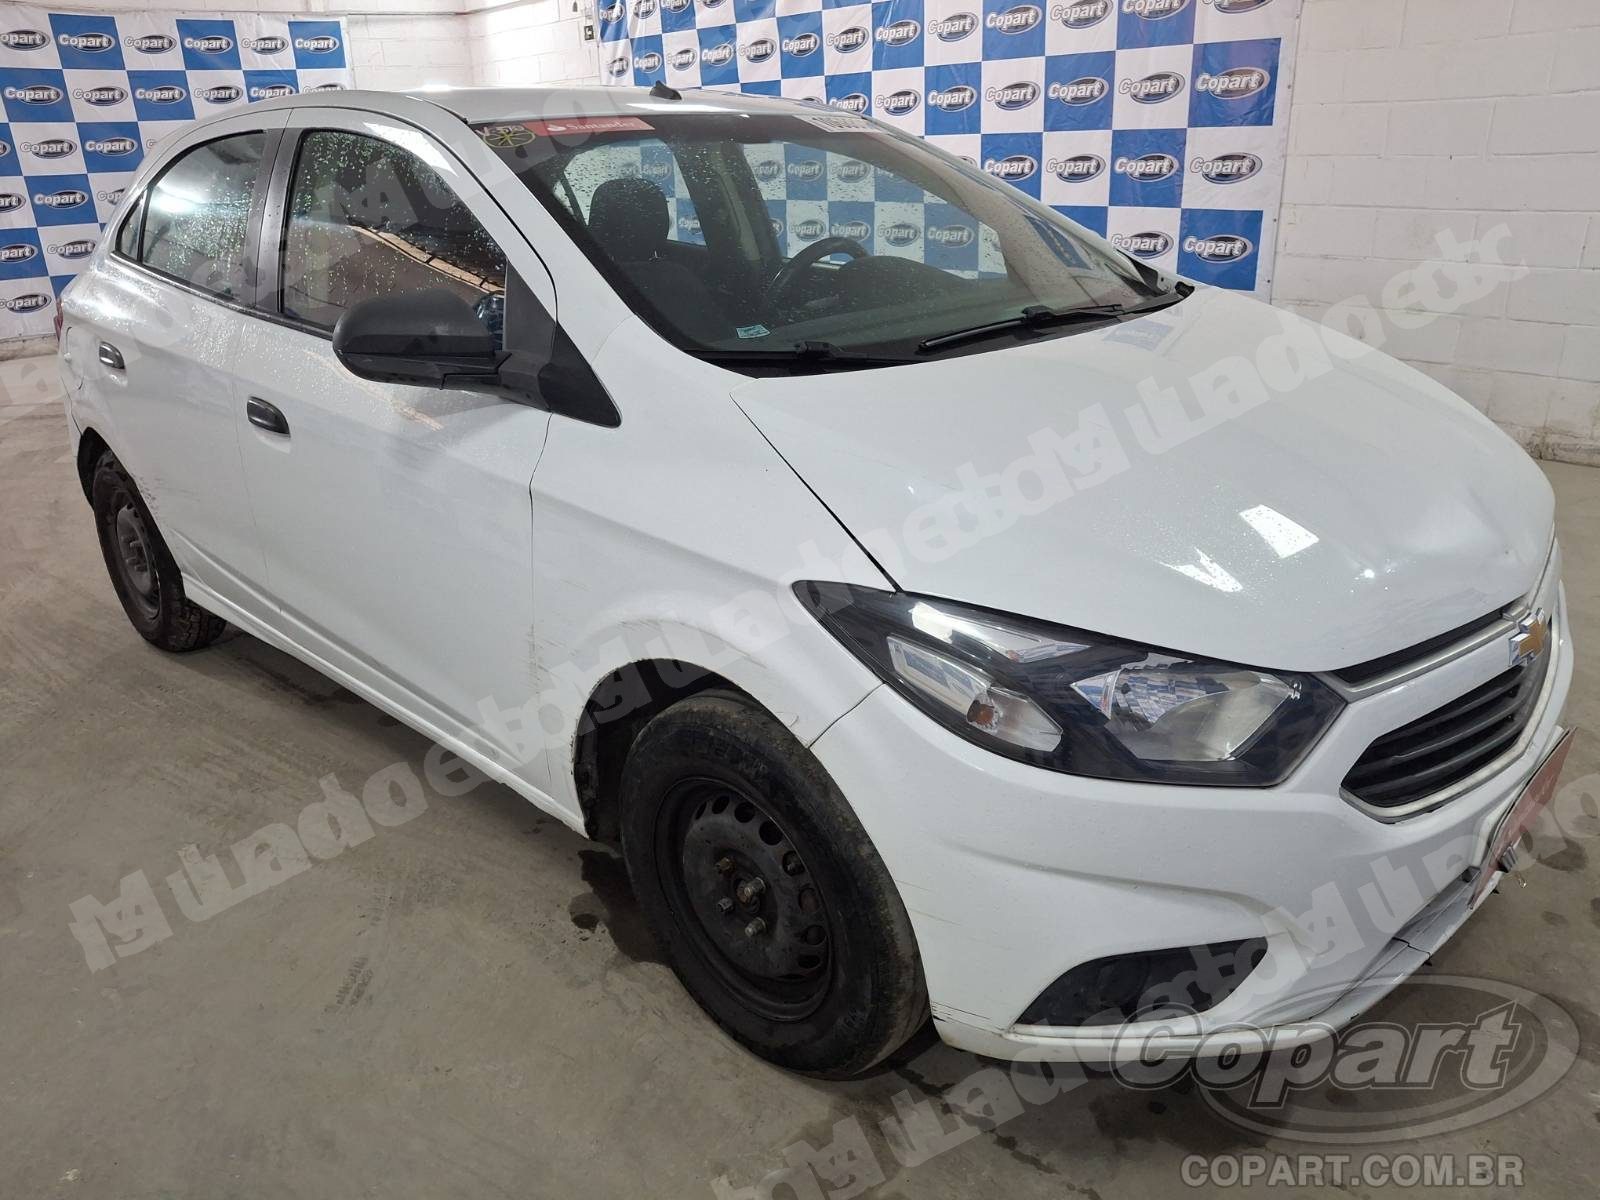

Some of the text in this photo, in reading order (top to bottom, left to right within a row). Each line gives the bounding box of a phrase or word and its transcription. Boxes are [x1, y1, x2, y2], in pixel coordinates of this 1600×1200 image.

[1051, 2, 1106, 22] Copart
[928, 17, 972, 35] Copart
[986, 11, 1035, 30] Copart
[0, 32, 42, 45] opart
[58, 34, 109, 48] Copart
[826, 30, 863, 47] Copart
[875, 24, 916, 42] Copart
[124, 36, 171, 49] Copart
[184, 37, 228, 50] Copart
[241, 38, 283, 50] Copart
[295, 38, 335, 50] Copart
[739, 43, 771, 57] Copart
[783, 37, 815, 52] Copart
[634, 55, 659, 68] Copart
[667, 51, 693, 66] Copart
[702, 49, 731, 63] Copart
[1048, 80, 1104, 101] Copart
[1119, 75, 1178, 97] Copart
[1195, 72, 1263, 94] Copart
[4, 86, 57, 101] Copart
[73, 88, 121, 102] Copart
[136, 88, 180, 102] Copart
[194, 88, 237, 102] Copart
[875, 92, 915, 111] Copart
[928, 89, 972, 107] Copart
[986, 84, 1034, 105] Copart
[20, 142, 70, 154] Copart
[85, 140, 132, 153] Copart
[787, 161, 820, 177] Copart
[984, 157, 1032, 176] Copart
[1046, 157, 1099, 176] Copart
[1114, 156, 1174, 176] Copart
[1190, 157, 1255, 177] Copart
[34, 193, 82, 205] Copart
[877, 222, 917, 240] Copart
[927, 226, 970, 243] Copart
[1111, 233, 1166, 254] Copart
[1184, 236, 1245, 258] Copart
[0, 246, 32, 261] part
